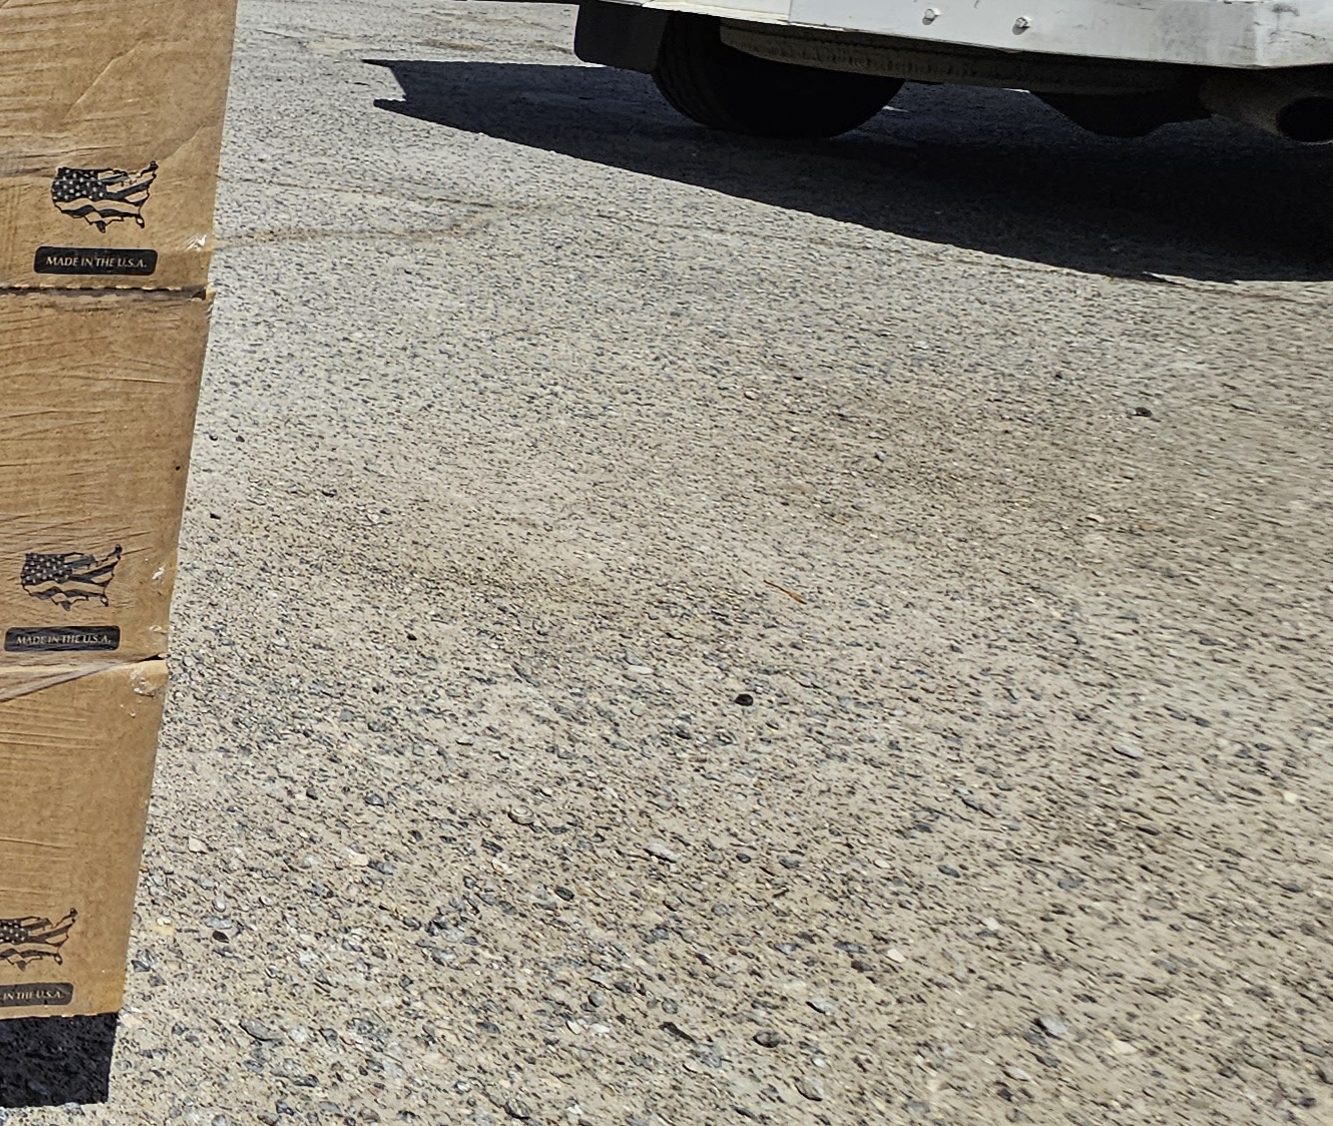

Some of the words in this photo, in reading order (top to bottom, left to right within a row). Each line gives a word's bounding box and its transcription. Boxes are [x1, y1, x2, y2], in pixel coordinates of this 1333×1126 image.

[46, 255, 77, 267] MADE
[81, 255, 95, 267] IN
[97, 256, 115, 268] THE
[117, 257, 147, 269] U.S.A.
